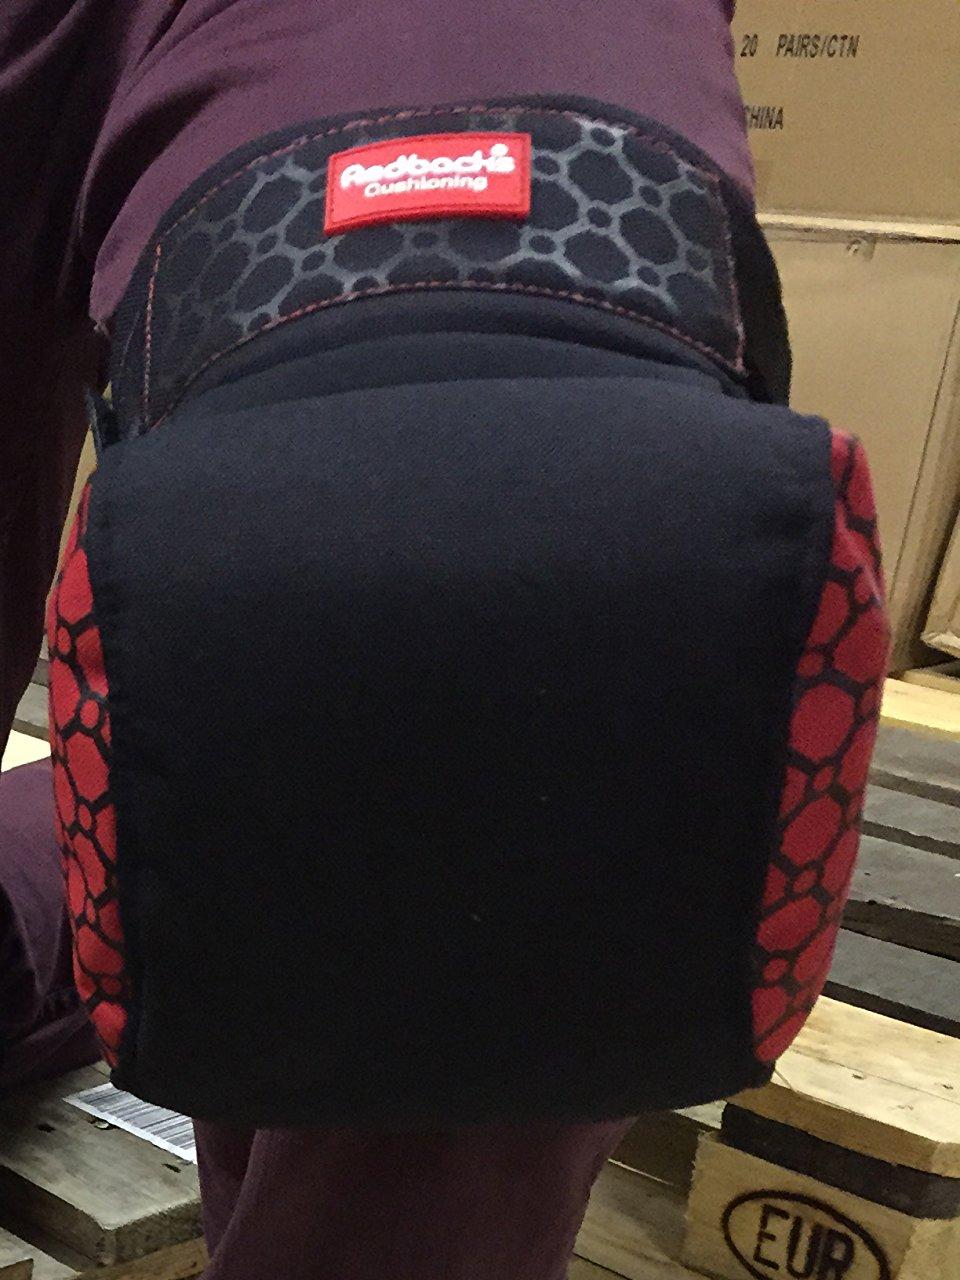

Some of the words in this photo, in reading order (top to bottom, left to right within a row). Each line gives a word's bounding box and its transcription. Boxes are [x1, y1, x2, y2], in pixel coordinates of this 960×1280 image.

[740, 33, 758, 57] 20
[776, 33, 860, 58] PAIRS/CTN
[364, 174, 488, 198] Cushioning
